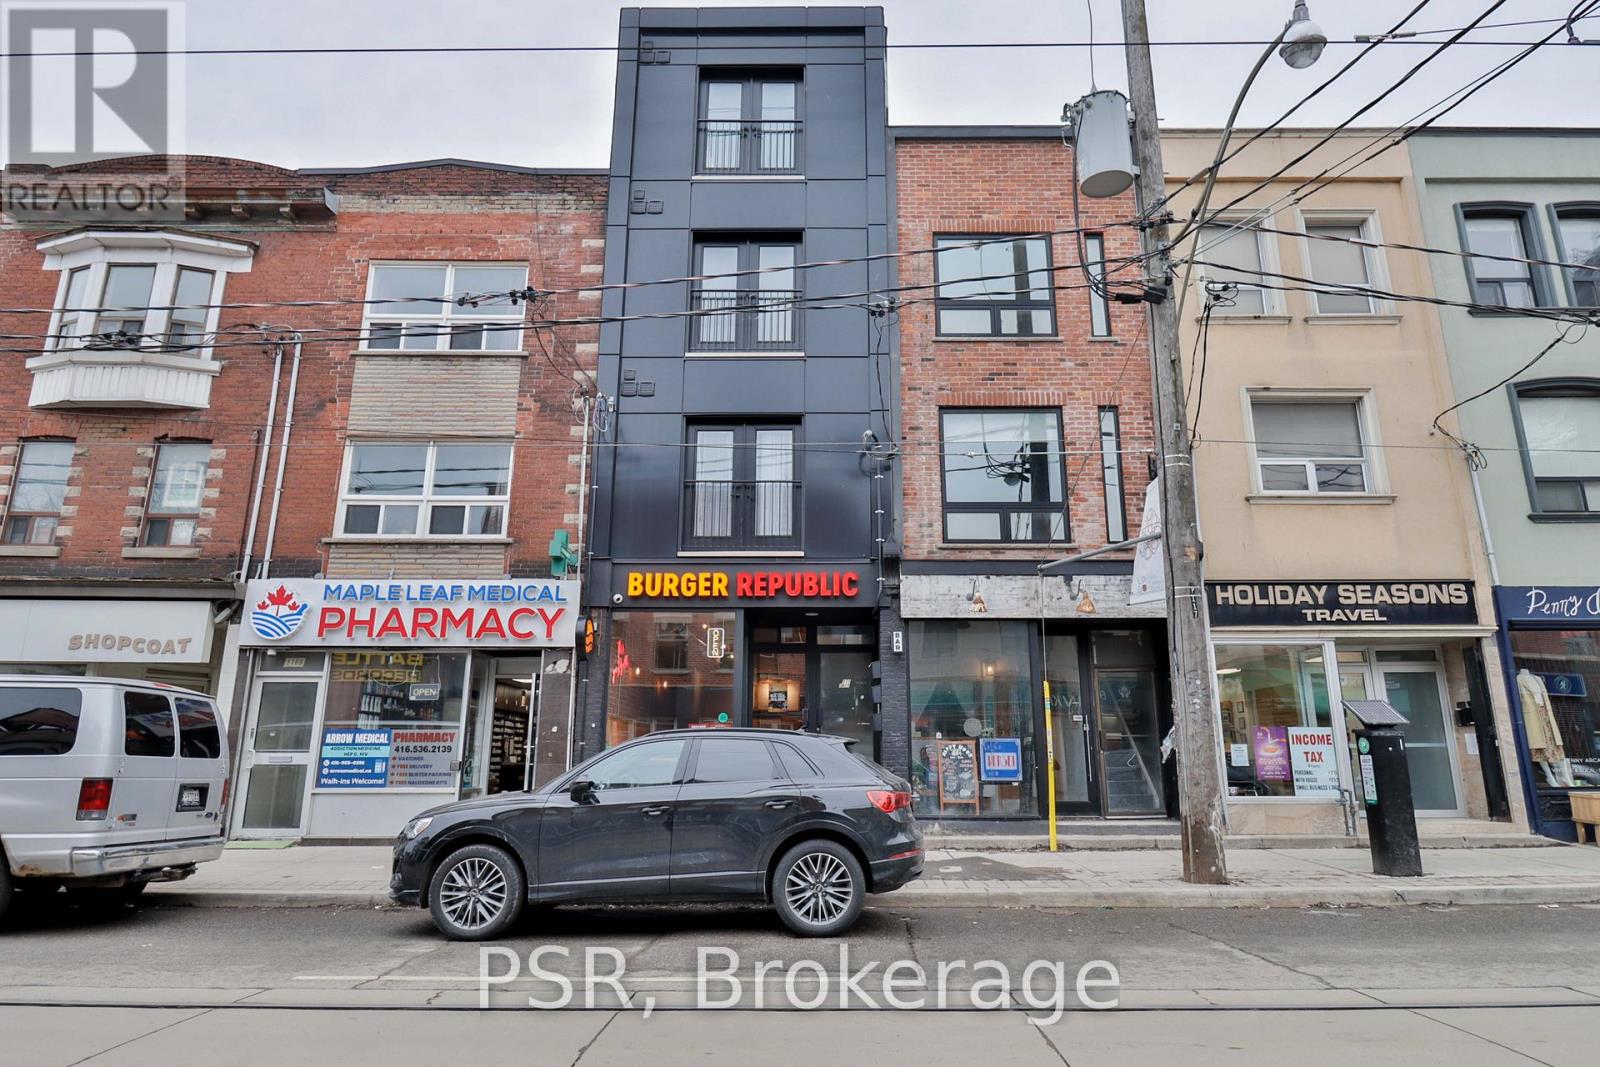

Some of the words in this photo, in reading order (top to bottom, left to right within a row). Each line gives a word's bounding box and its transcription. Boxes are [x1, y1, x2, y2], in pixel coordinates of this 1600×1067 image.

[628, 572, 729, 597] BURGER
[736, 572, 859, 597] REPUBLIC
[323, 584, 401, 601] MAPLE
[406, 584, 463, 601] LEAF
[467, 585, 567, 602] MEDICAL
[1215, 585, 1328, 605] HOLIDAY
[1338, 583, 1468, 605] SEASONS
[1526, 587, 1583, 617] Penny
[1302, 609, 1387, 621] TRAVEL
[317, 607, 566, 639] PHARMACY
[68, 633, 192, 655] SHOPCOAT
[712, 629, 720, 656] OPEN
[413, 688, 437, 696] OPEN
[325, 733, 354, 743] ARROW
[355, 733, 388, 744] MEDICAL
[393, 732, 456, 743] PHARMACY
[1291, 734, 1332, 745] INCOME
[394, 745, 453, 753] 416.536.2139
[1304, 751, 1323, 762] TAX
[351, 777, 385, 785] Welcome!
